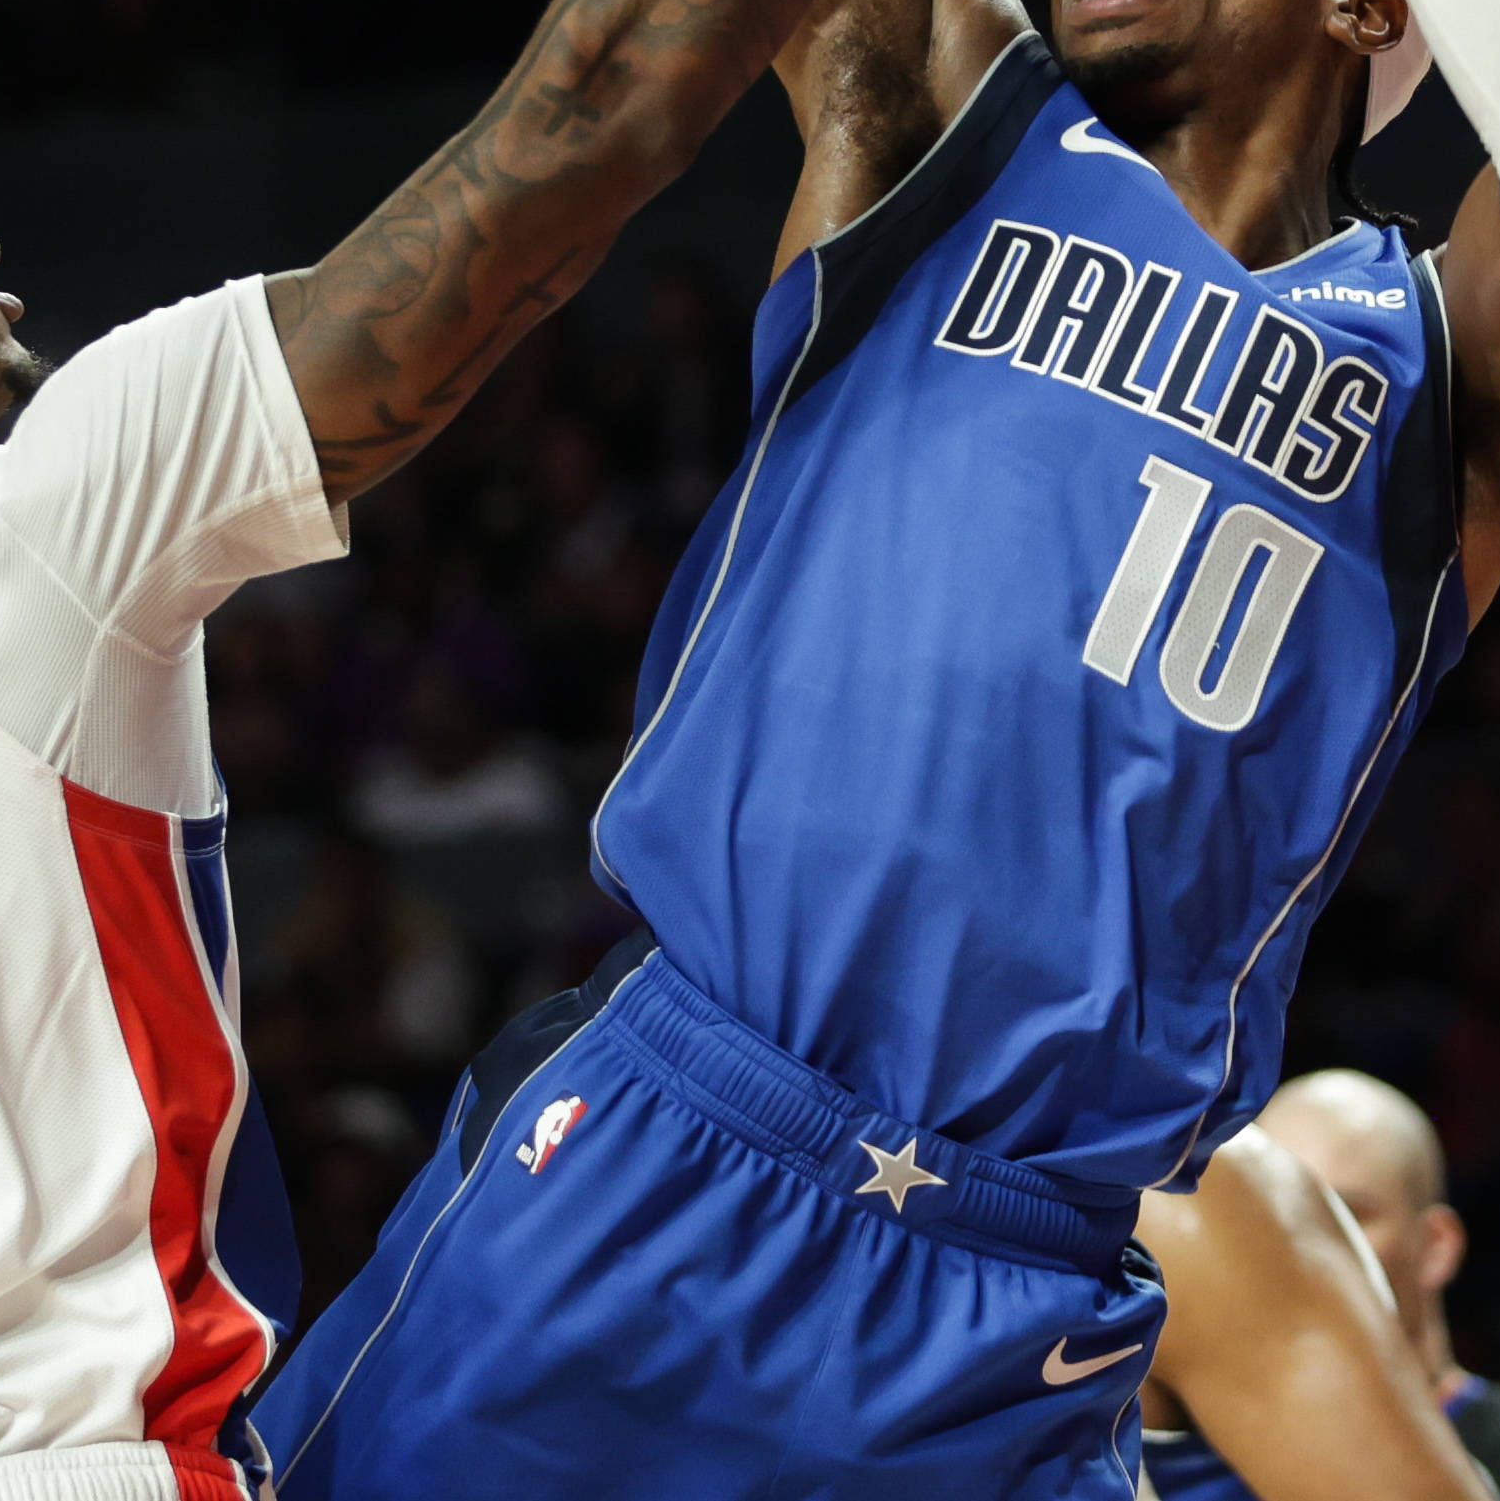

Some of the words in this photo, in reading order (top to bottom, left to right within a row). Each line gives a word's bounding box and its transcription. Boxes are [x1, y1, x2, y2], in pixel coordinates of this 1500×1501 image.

[933, 218, 1389, 504] DALLAS
[1278, 280, 1407, 310] hime
[1082, 453, 1325, 732] 10
